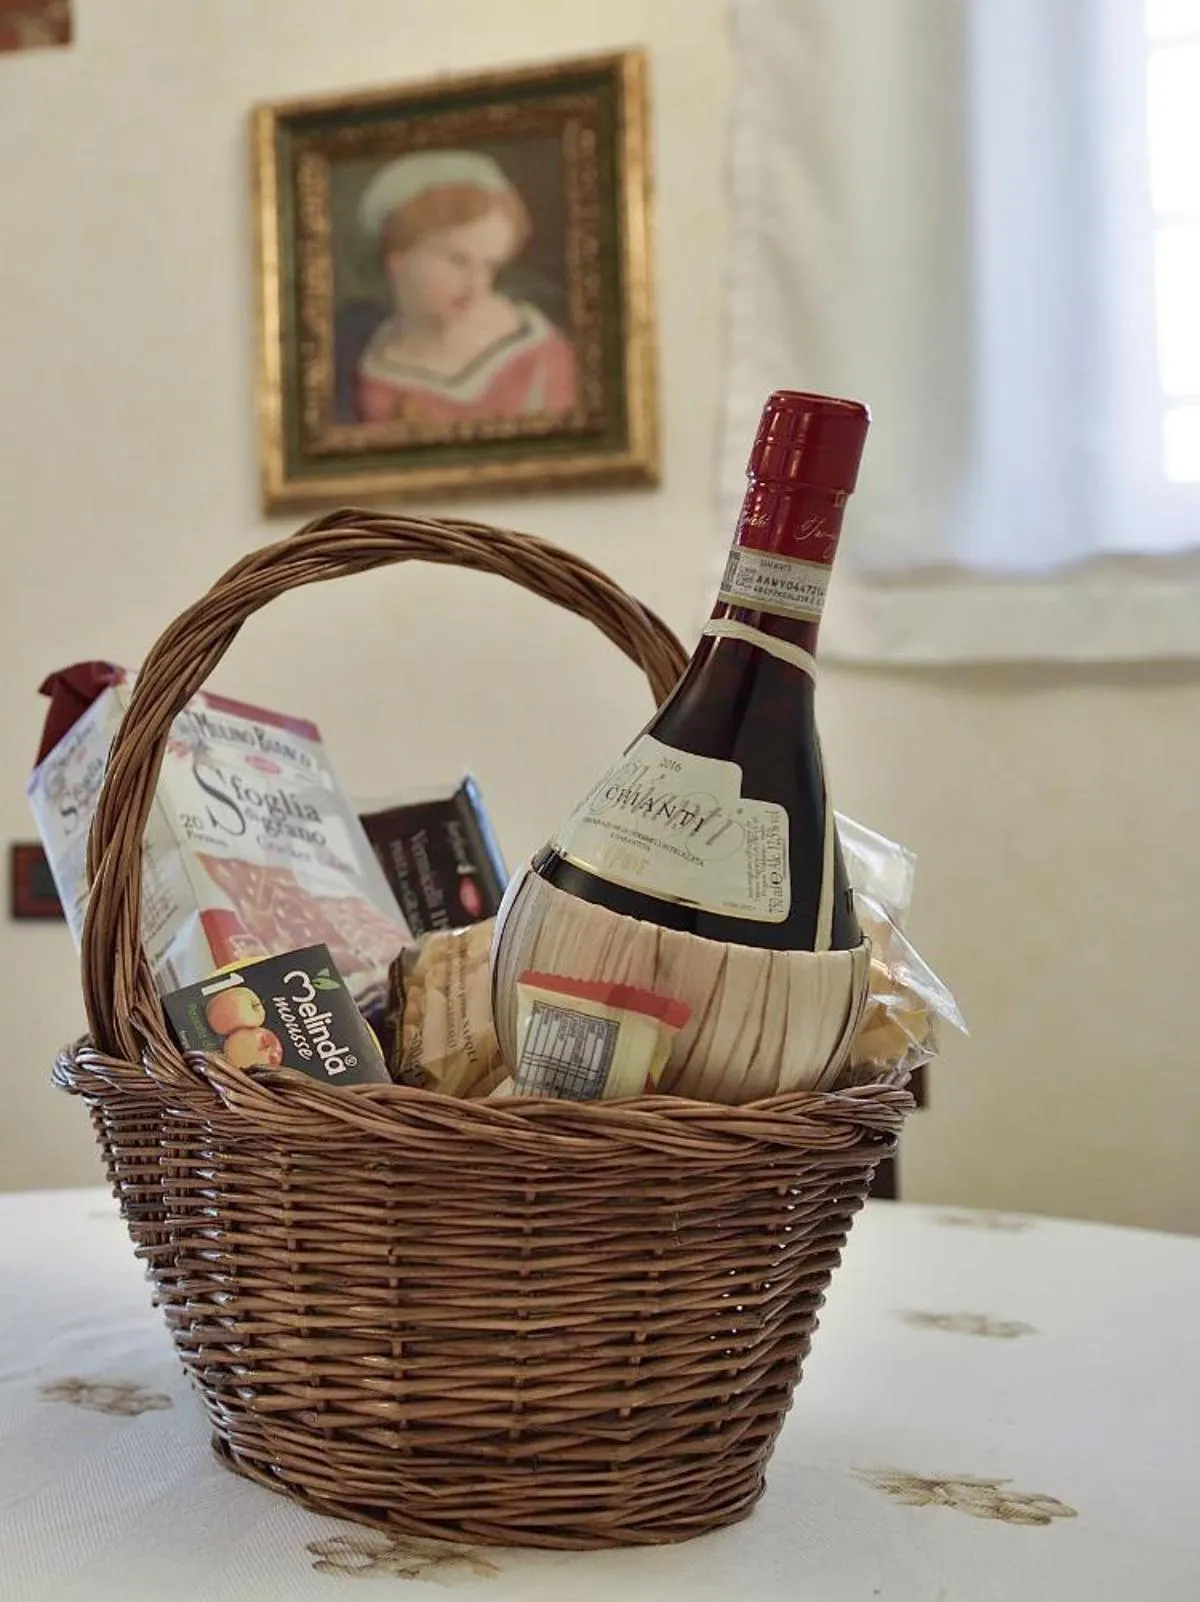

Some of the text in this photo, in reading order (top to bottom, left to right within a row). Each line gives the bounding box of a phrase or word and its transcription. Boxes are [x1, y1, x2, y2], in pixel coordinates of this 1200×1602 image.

[660, 757, 682, 773] 2016
[193, 764, 321, 836] Sfoglia
[605, 786, 705, 833] CHIANTI
[272, 996, 313, 1061] mousse
[284, 971, 347, 1076] Melinda
